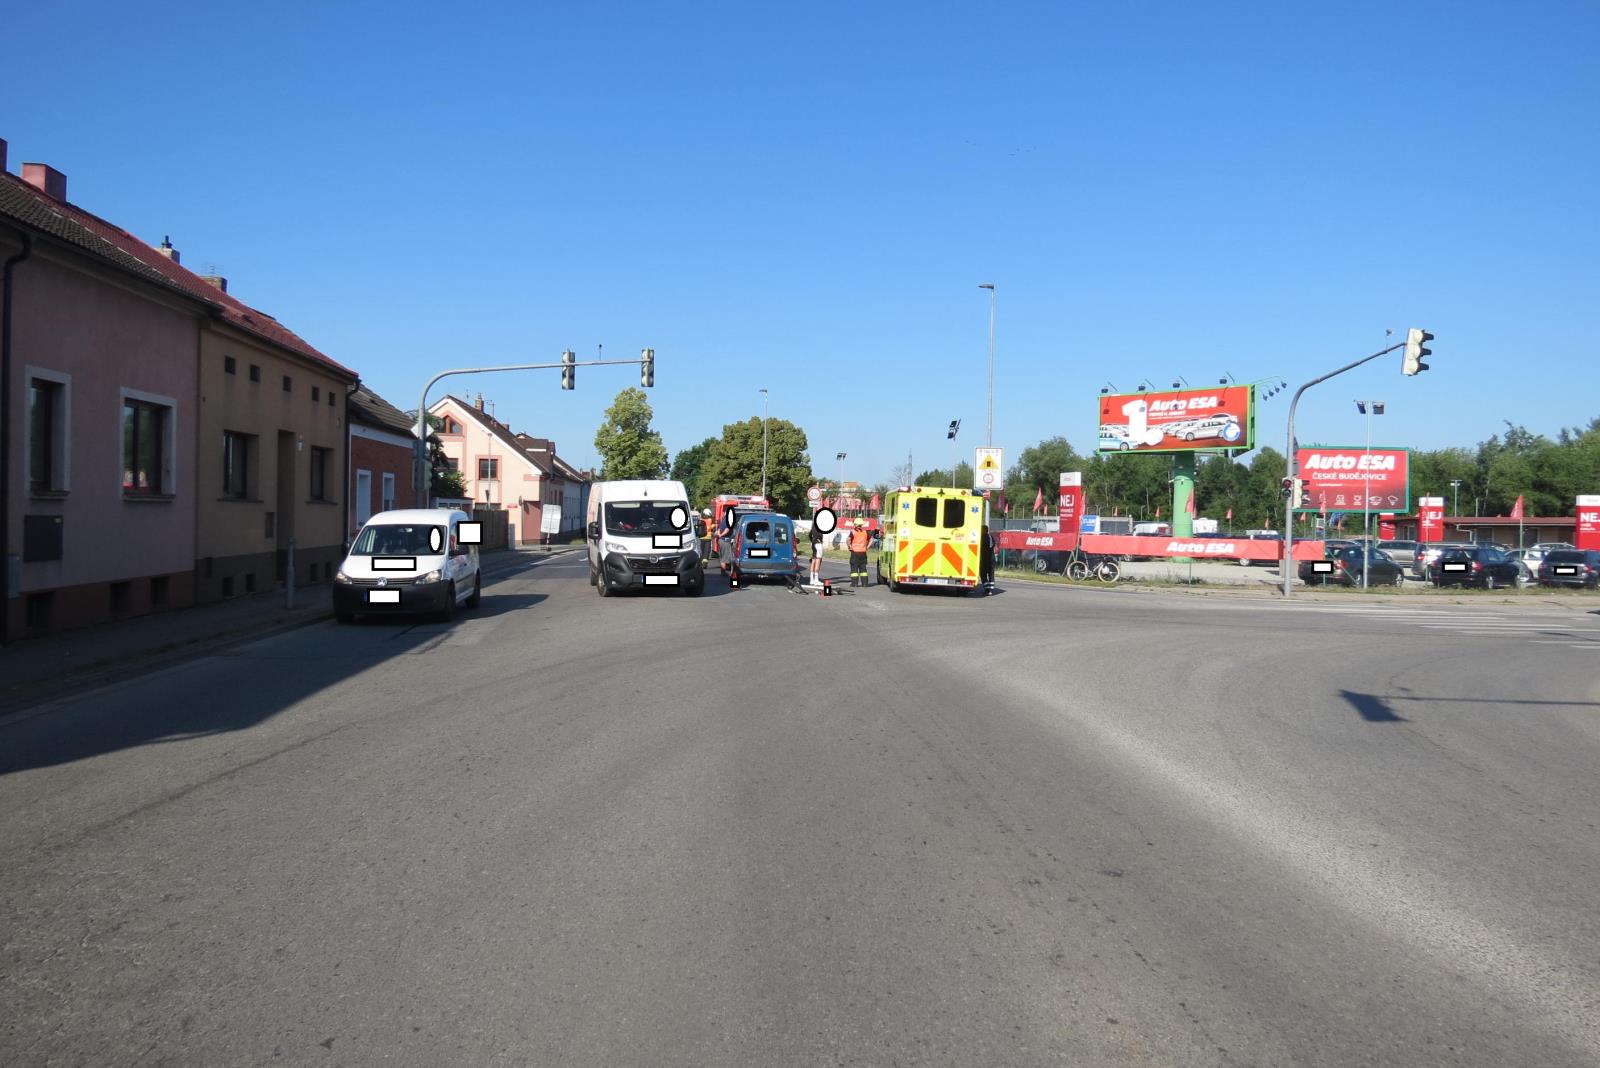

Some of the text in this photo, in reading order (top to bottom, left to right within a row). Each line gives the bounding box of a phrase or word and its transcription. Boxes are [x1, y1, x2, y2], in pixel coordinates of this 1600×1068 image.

[1148, 396, 1218, 412] Auto ESA
[1304, 454, 1395, 470] Auto ESA
[1312, 471, 1388, 481] ČESKÉ BUDĚJOVICE
[1060, 495, 1074, 507] NEJ
[1040, 537, 1054, 546] ESA
[1166, 541, 1235, 554] Auto ESA
